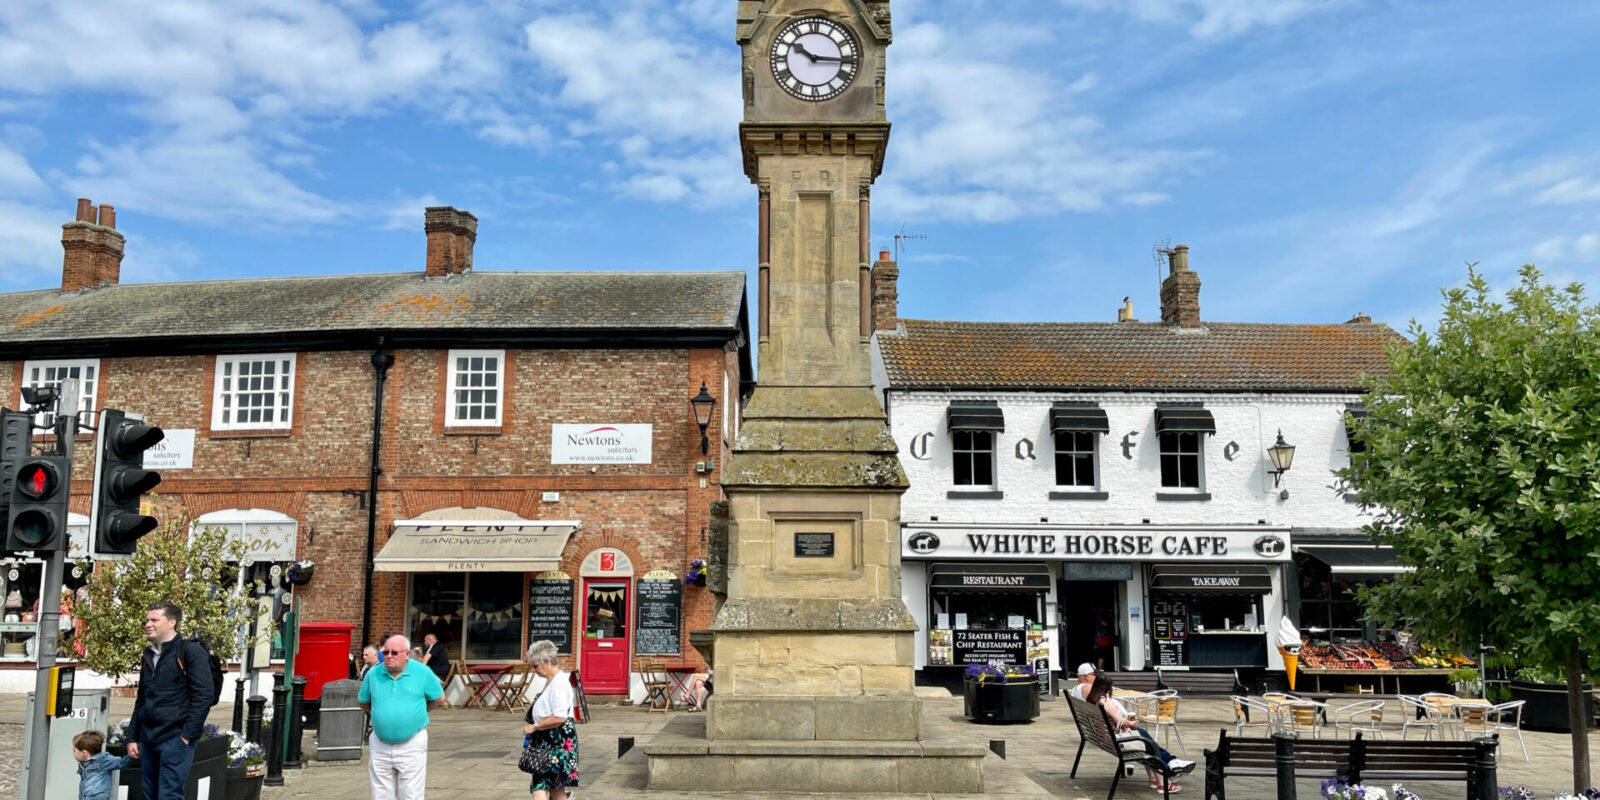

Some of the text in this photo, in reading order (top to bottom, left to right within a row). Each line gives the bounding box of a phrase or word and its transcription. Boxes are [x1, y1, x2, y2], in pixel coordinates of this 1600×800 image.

[567, 434, 621, 446] Newtons
[910, 431, 1240, 462] Cafe
[420, 537, 539, 545] SANDWICH SHOP
[966, 534, 1228, 556] WHITE HORSE CAFE
[602, 553, 614, 570] 3
[962, 576, 1025, 585] RESTAURANT
[1191, 577, 1240, 586] TAKEAWAY
[957, 632, 1020, 640] 72 SEATER FISH &
